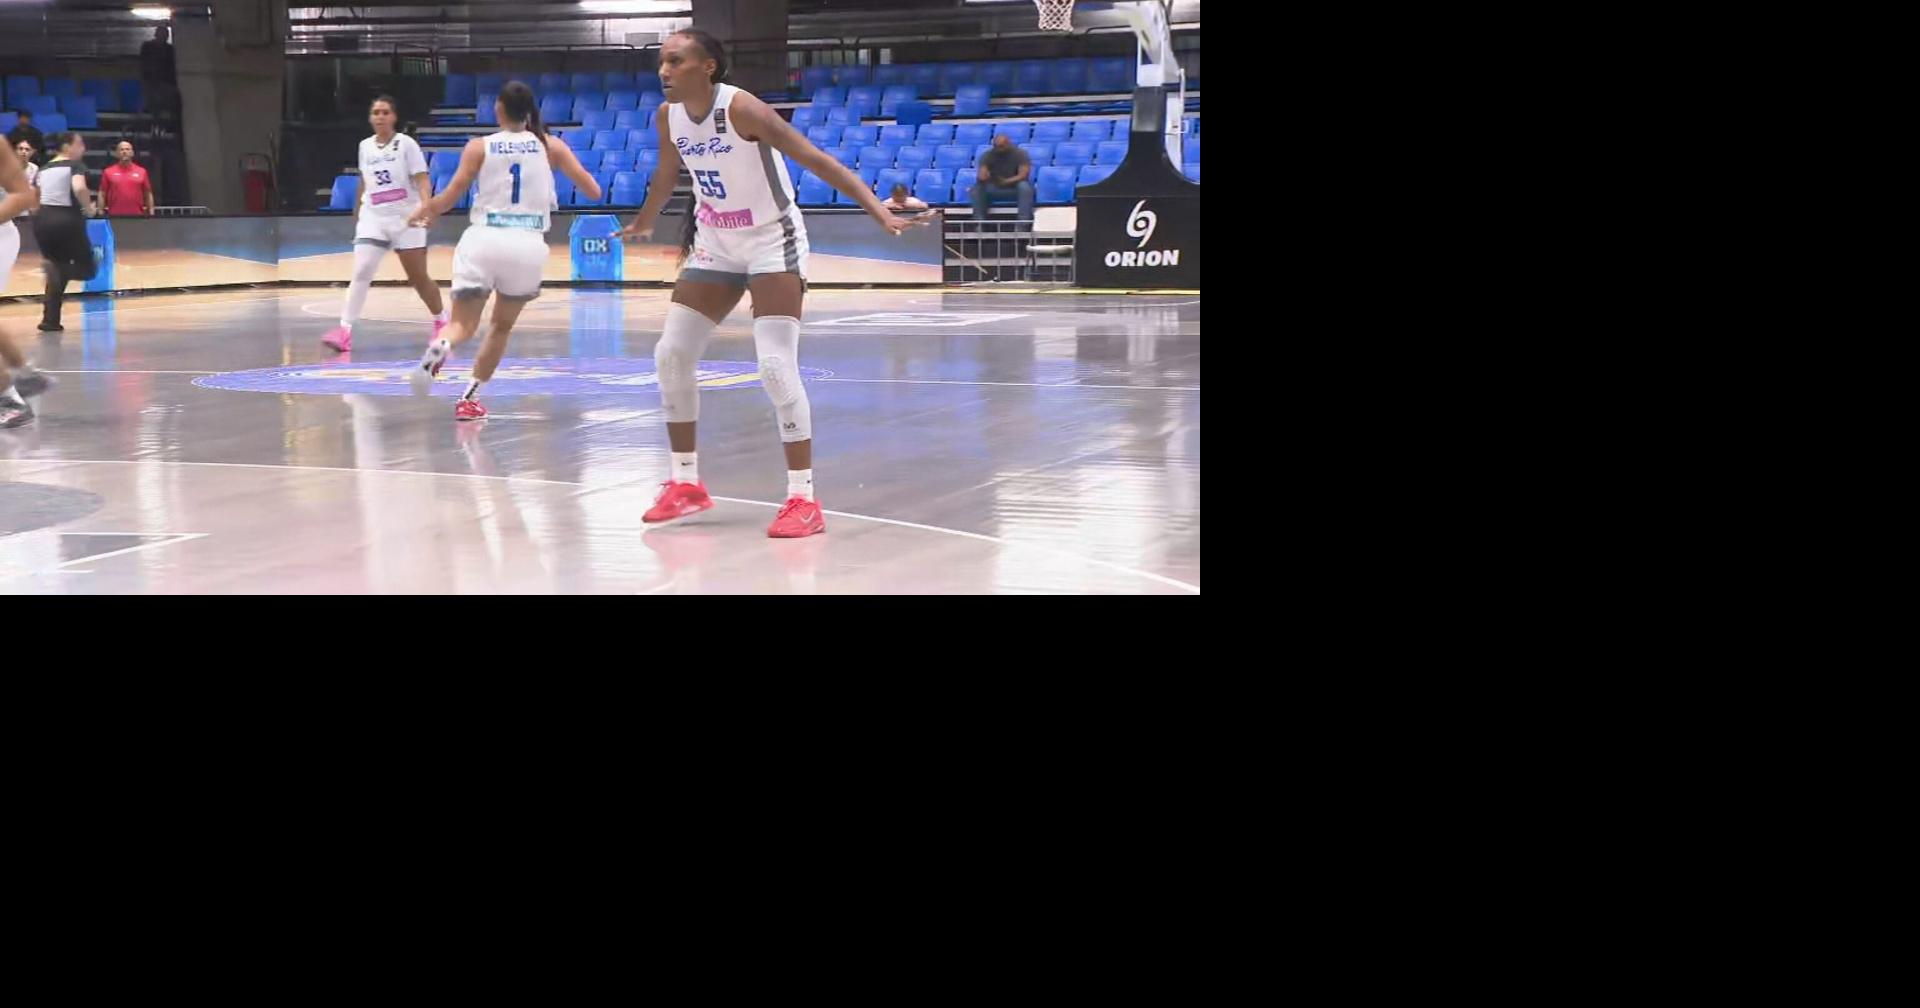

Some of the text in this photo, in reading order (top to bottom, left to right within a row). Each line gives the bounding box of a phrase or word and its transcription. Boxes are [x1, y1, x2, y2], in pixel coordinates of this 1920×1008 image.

[708, 137, 733, 158] Rico
[374, 169, 392, 186] 33
[509, 163, 521, 204] 1
[694, 170, 726, 199] 55
[1104, 250, 1179, 267] ORION
